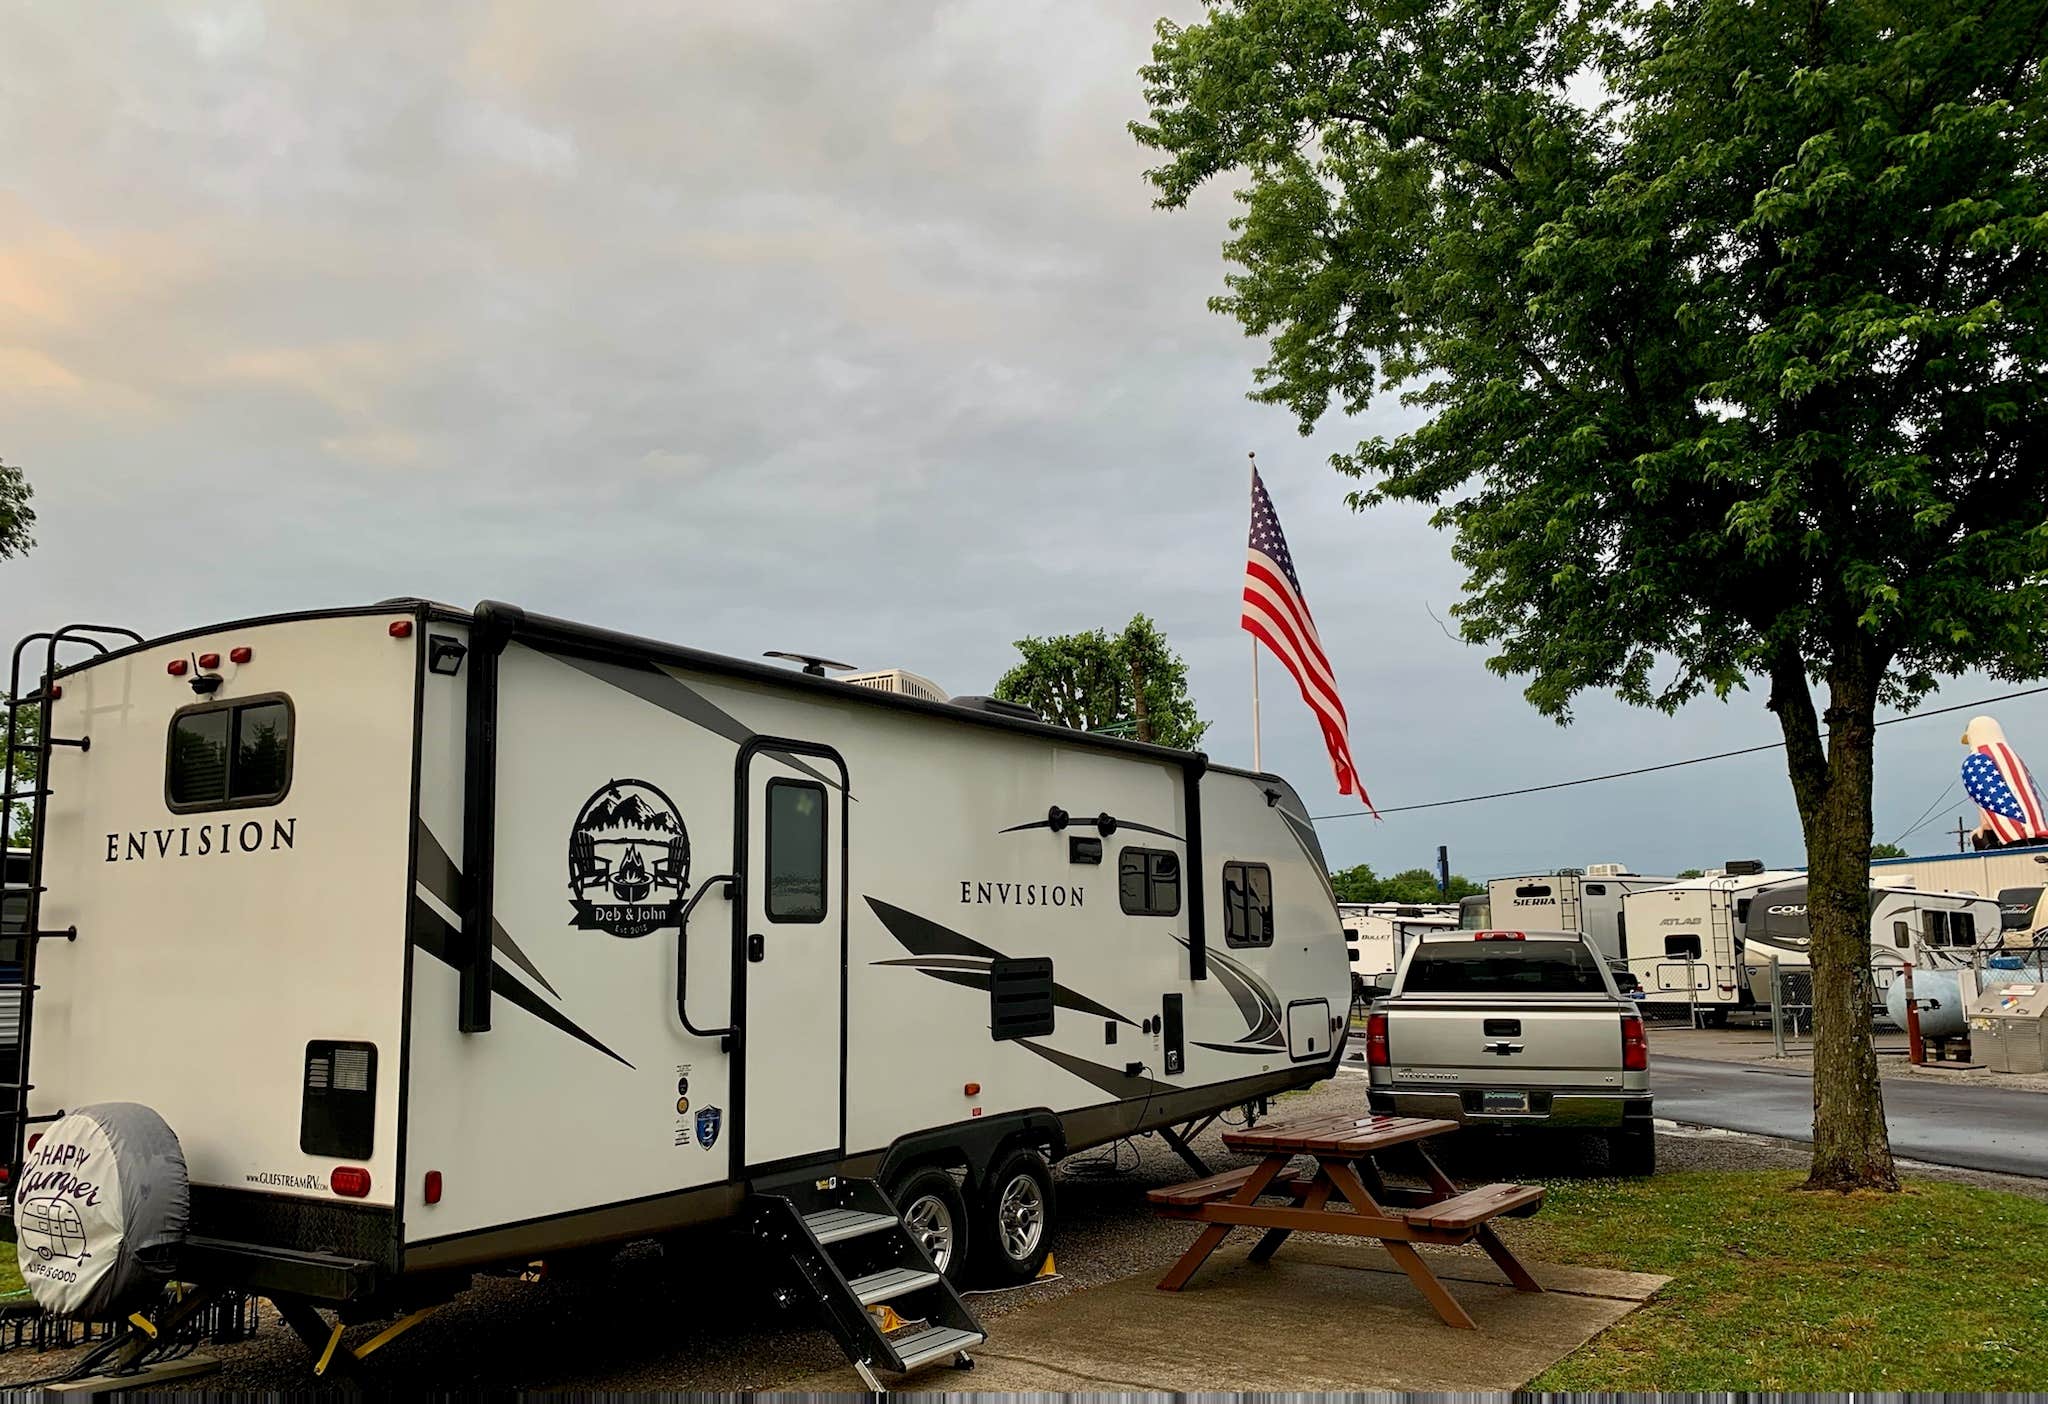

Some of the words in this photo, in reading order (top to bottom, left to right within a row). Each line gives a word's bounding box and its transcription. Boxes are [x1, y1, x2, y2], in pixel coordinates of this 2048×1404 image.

[105, 818, 296, 862] ENVISION
[960, 881, 1084, 907] ENVISION
[1513, 898, 1556, 906] SIERRA
[1768, 905, 1807, 914] COU
[595, 907, 621, 921] Deb
[625, 908, 634, 920] &
[637, 906, 666, 922] John
[1659, 917, 1702, 926] ATLAS
[17, 1152, 102, 1207] Camper
[52, 1269, 77, 1283] GOOD
